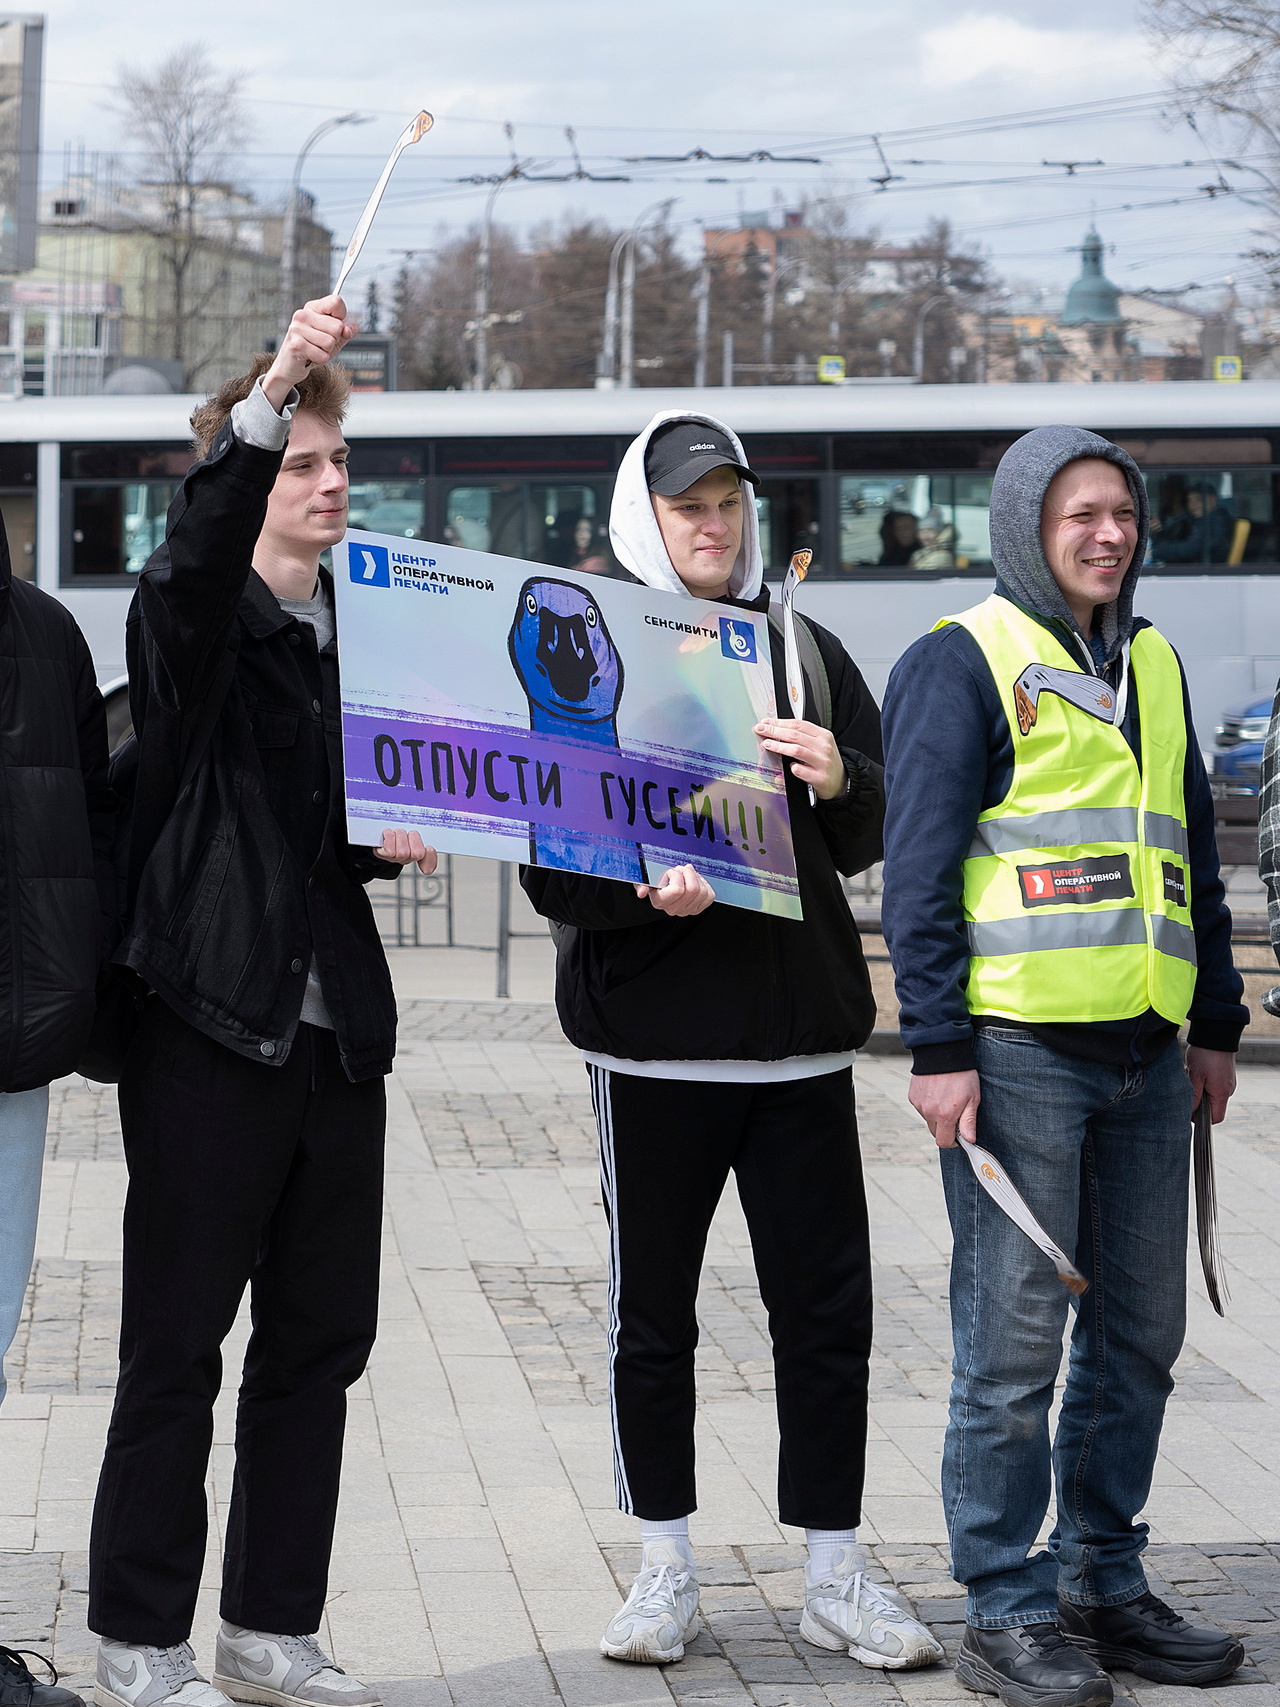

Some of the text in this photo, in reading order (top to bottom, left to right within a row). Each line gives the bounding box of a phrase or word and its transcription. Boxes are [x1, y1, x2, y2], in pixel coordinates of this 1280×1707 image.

[689, 443, 716, 451] adidas
[391, 552, 437, 568] ЦЕНТР
[393, 565, 495, 592] ОПЕРАТИВНОЙ
[394, 577, 449, 595] ПЕЧАТИ
[644, 615, 719, 640] СЕНСИВИТИ
[373, 733, 767, 856] ОТПУСТИ ГУСЕЙ!!!
[1052, 868, 1083, 878] ЦЕНТР
[1054, 871, 1122, 886] ОПЕРАТИВНОЙ
[1056, 884, 1094, 895] ПЕЧАТИ
